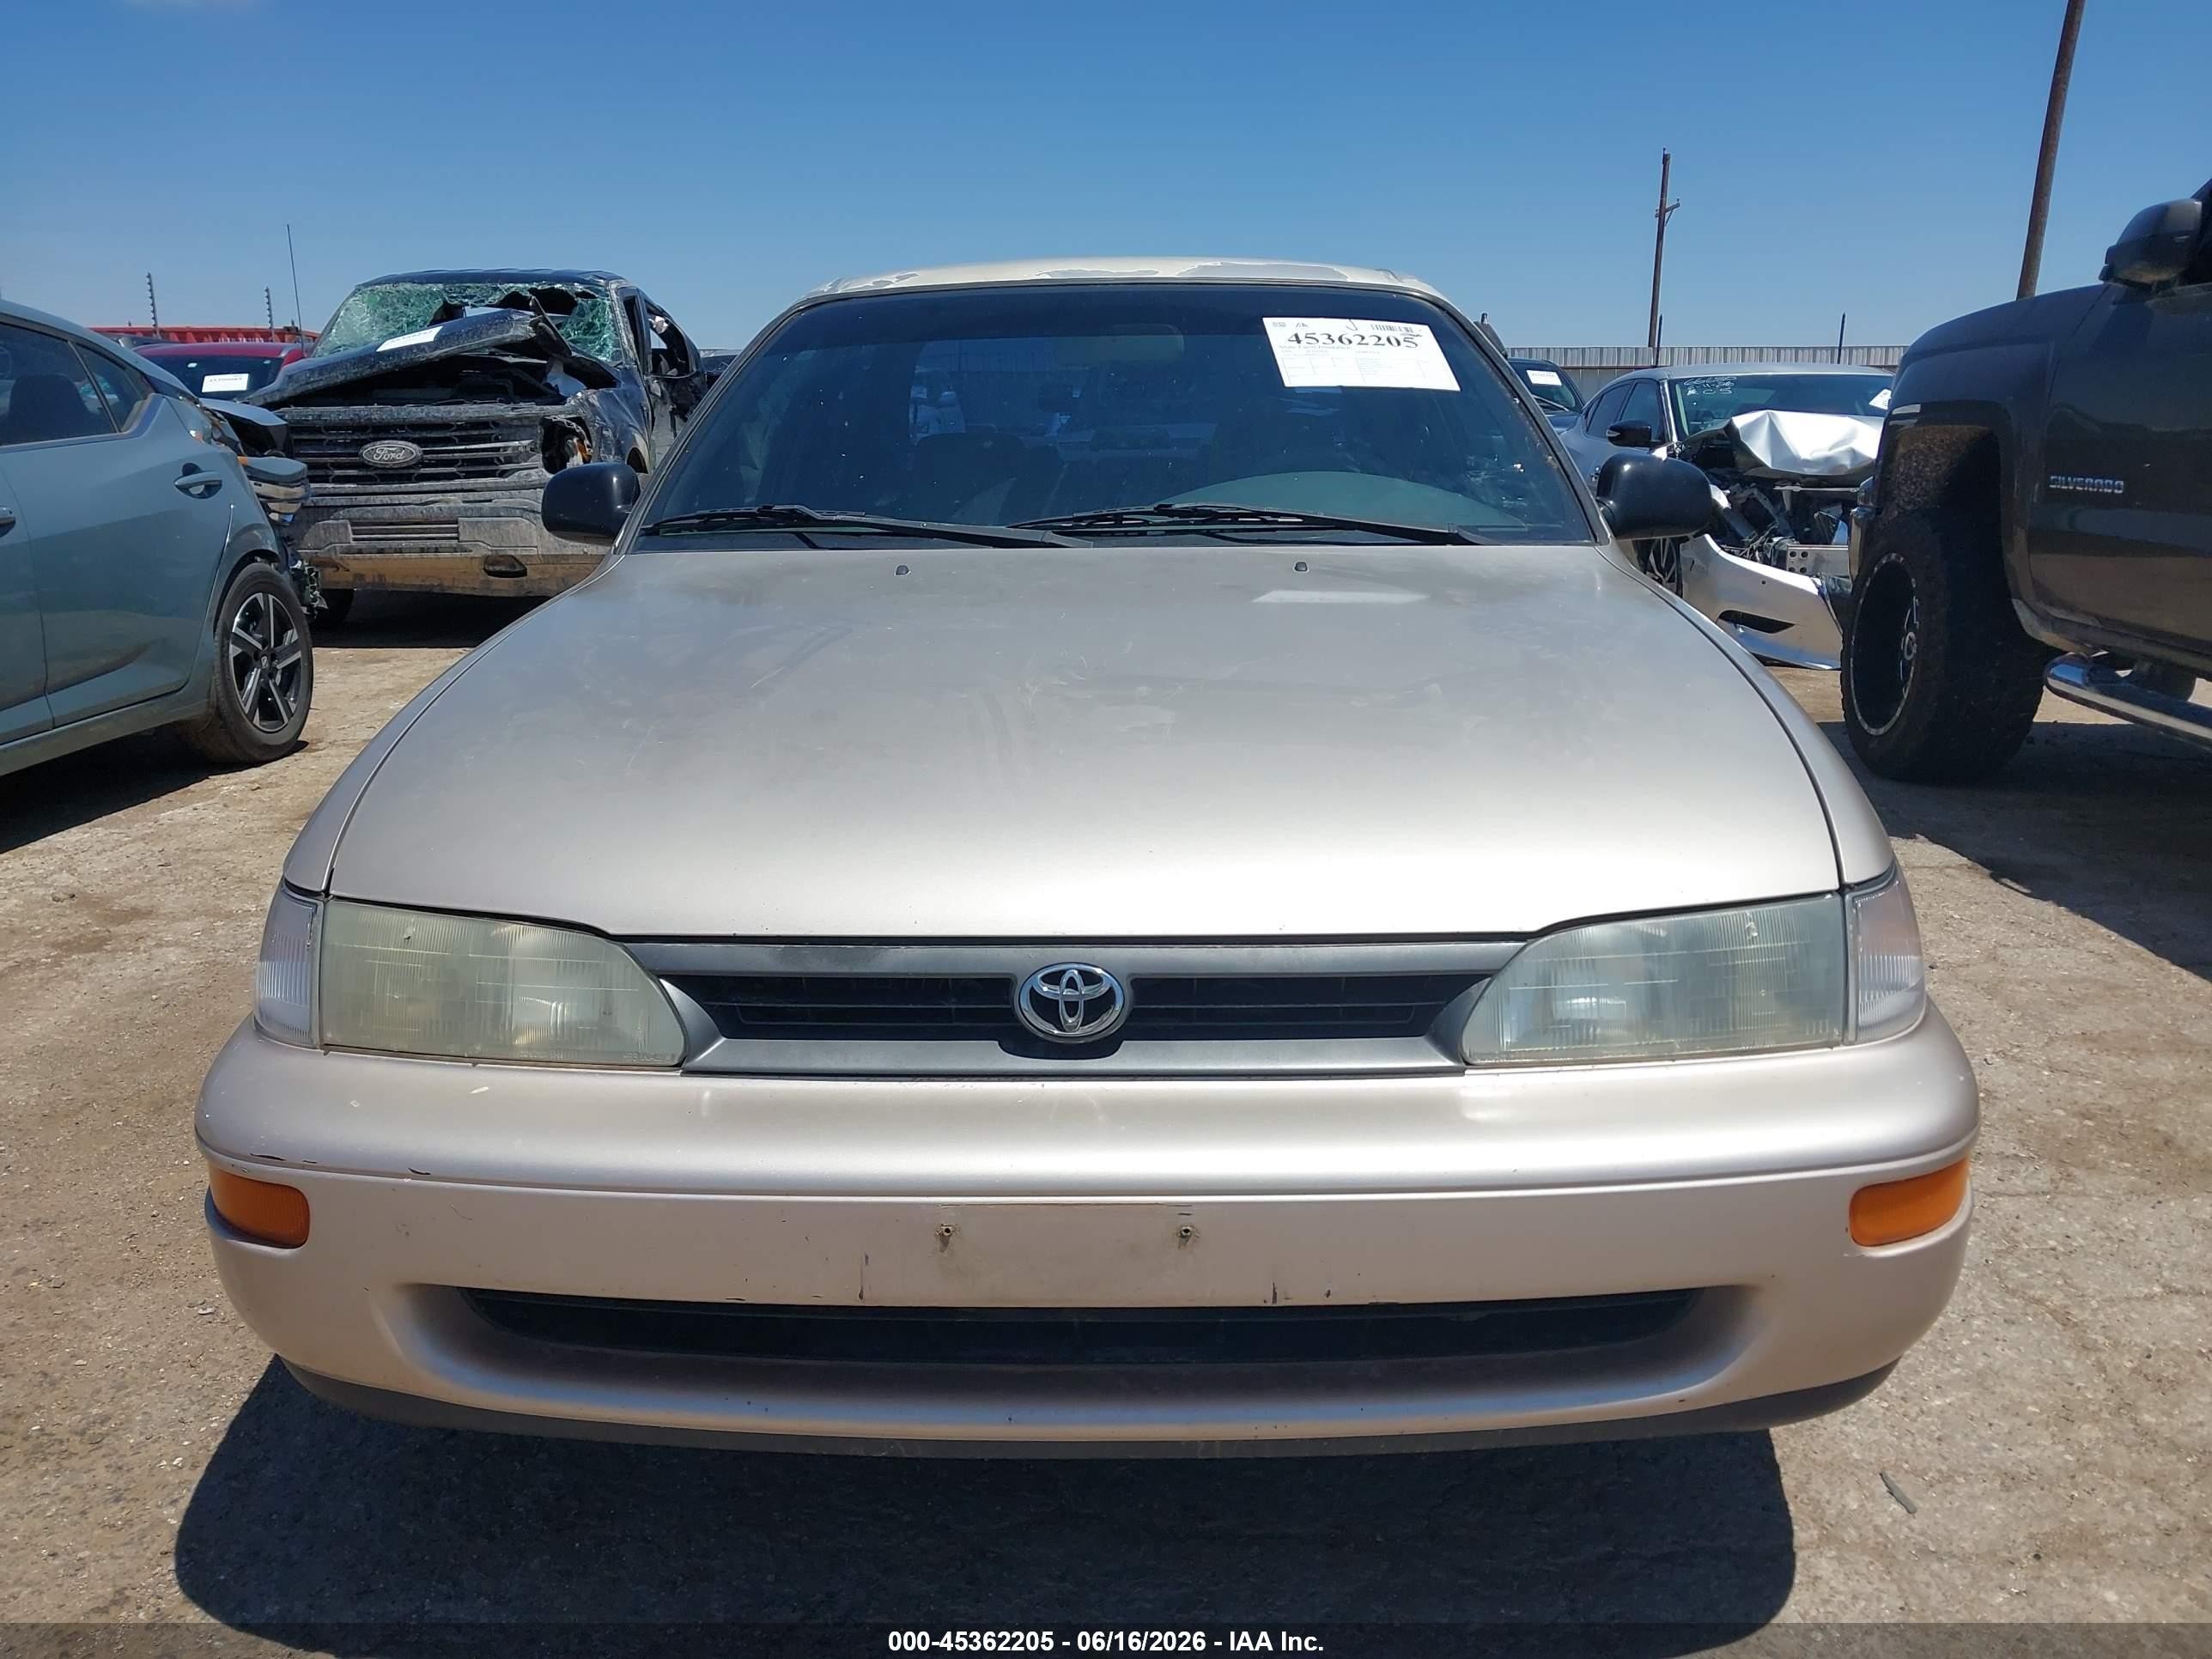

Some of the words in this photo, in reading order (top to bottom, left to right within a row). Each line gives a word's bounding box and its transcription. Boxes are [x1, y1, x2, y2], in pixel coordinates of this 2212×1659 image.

[1287, 331, 1419, 349] 45362205
[373, 447, 406, 461] Ford
[2049, 475, 2124, 494] SILVERADO
